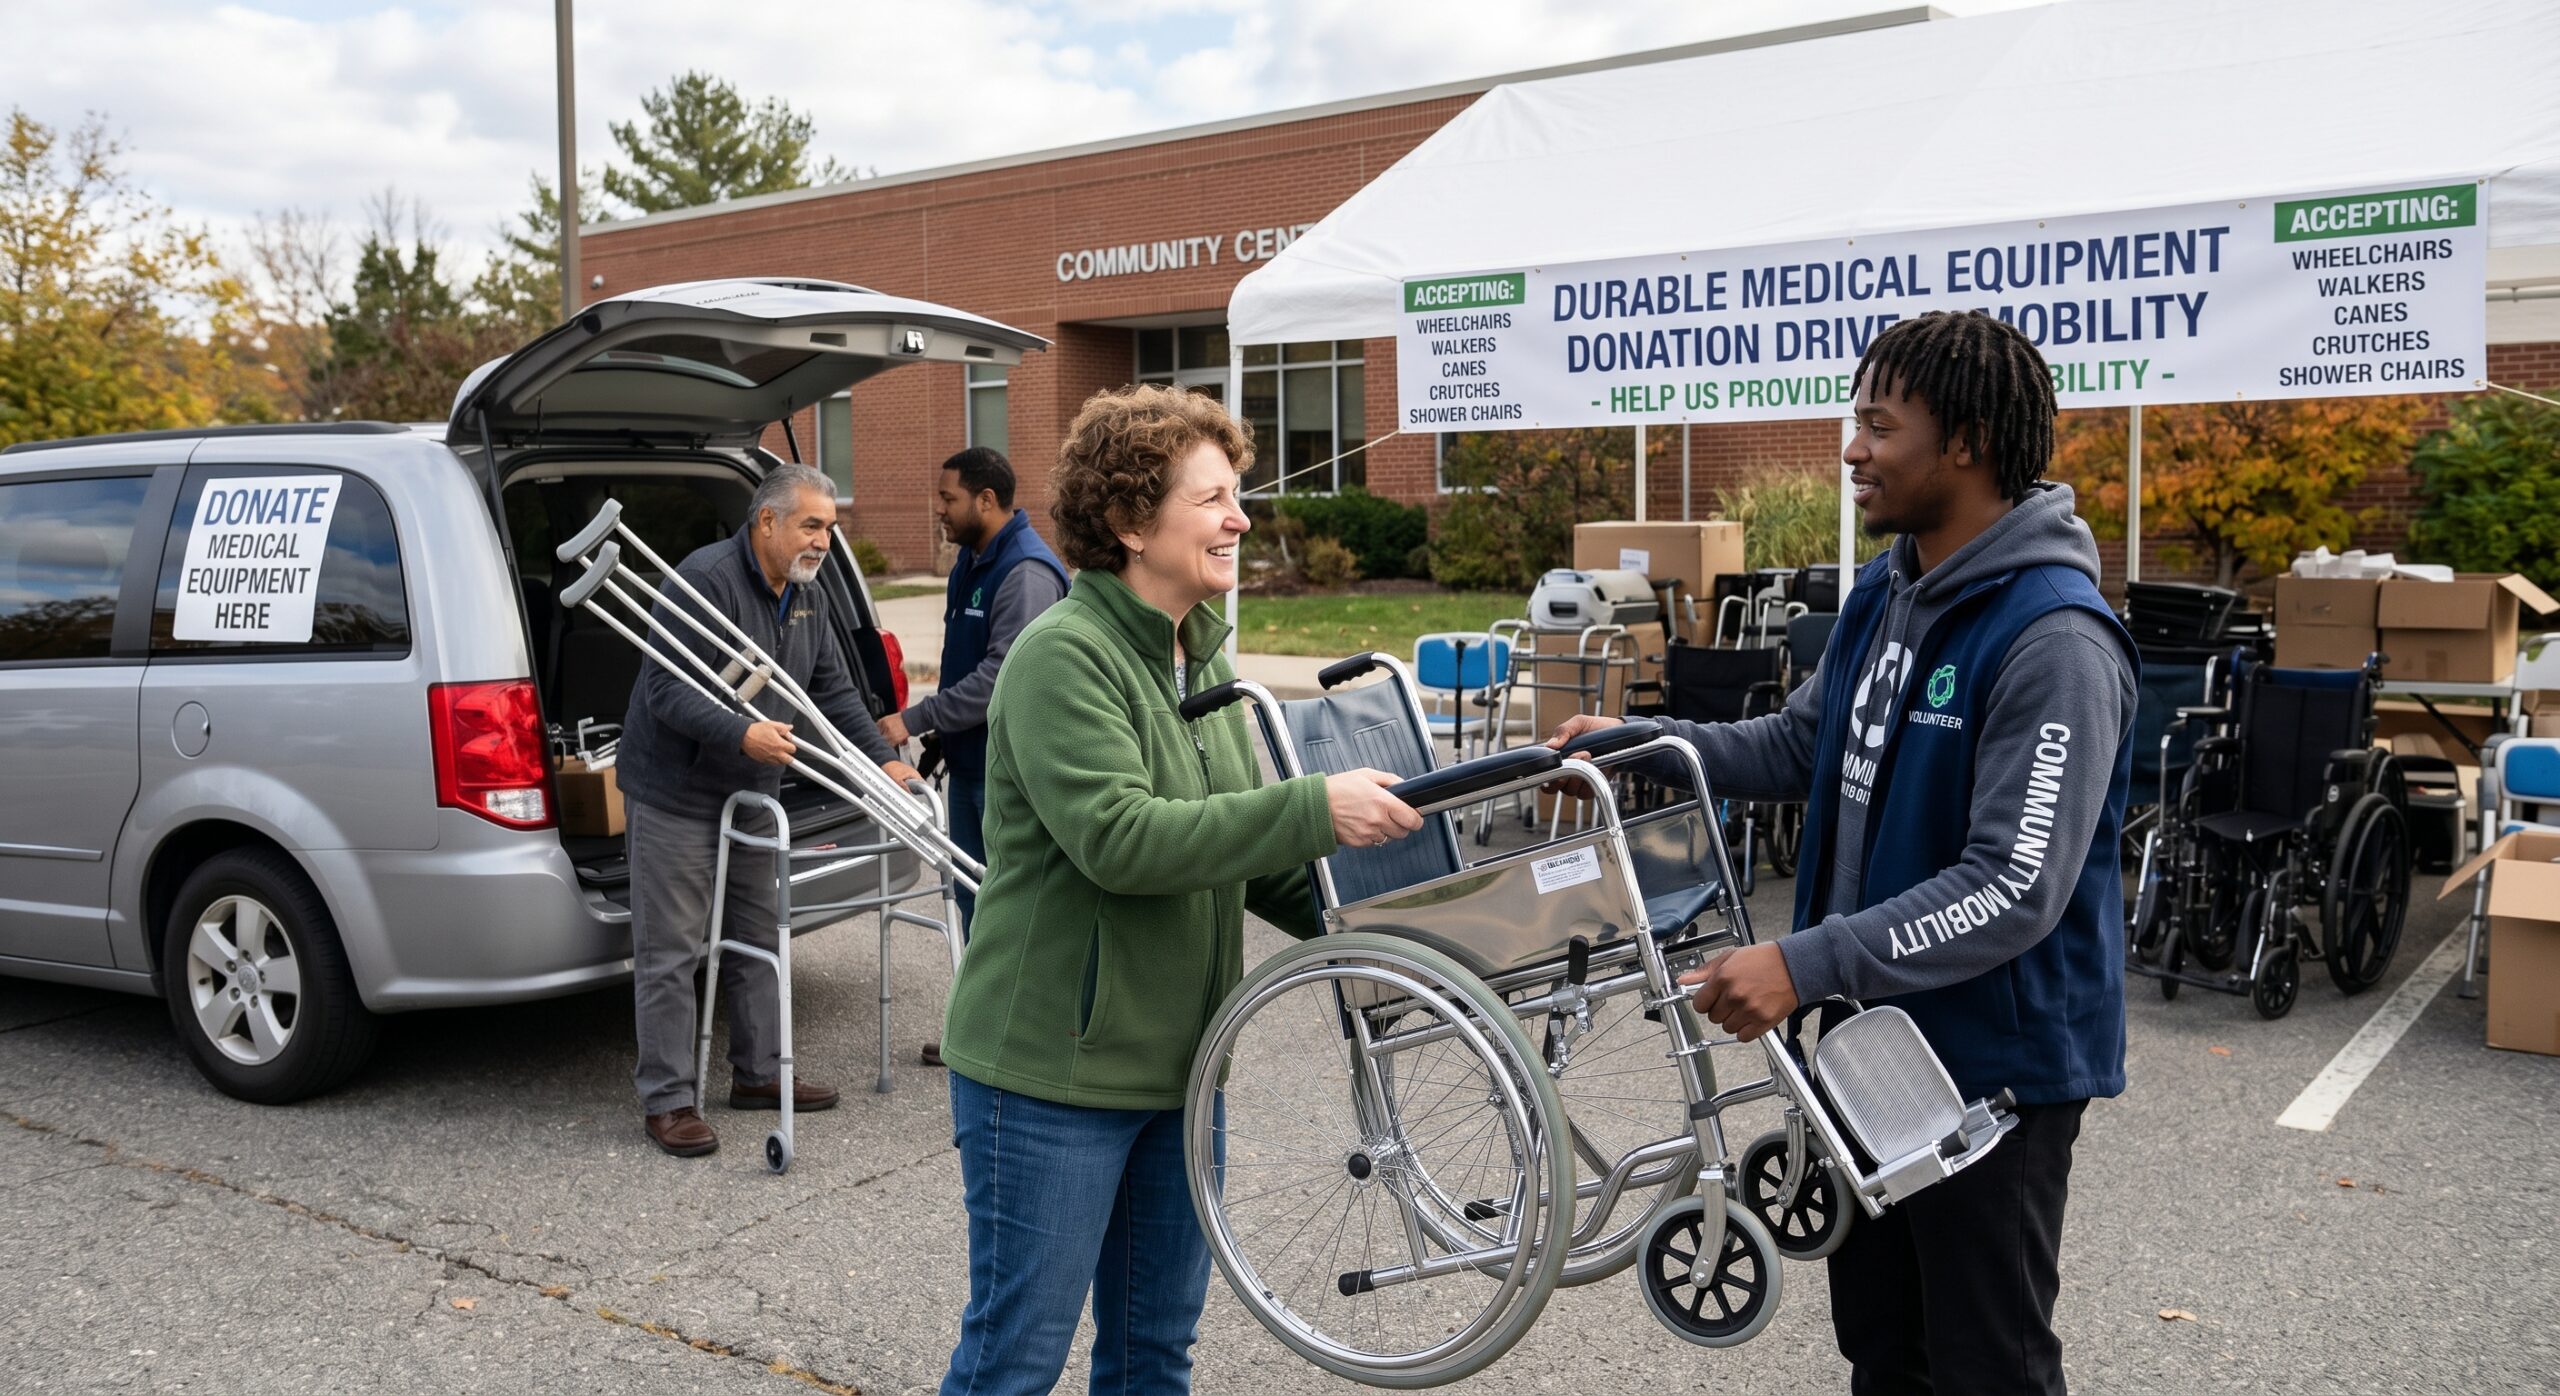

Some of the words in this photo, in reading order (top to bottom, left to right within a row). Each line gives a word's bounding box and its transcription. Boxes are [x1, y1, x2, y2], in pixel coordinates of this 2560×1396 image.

[2291, 196, 2458, 233] ACCEPTING:
[1056, 235, 1223, 282] COMMUNITY
[2291, 239, 2453, 271] WHEELCHAIRS
[1554, 271, 1728, 322] DURABLE
[1743, 254, 1931, 309] MEDICAL
[1948, 226, 2231, 296] EQUIPMENT
[2317, 270, 2426, 298] WALKERS
[1415, 280, 1515, 306] ACCEPTING:
[1416, 312, 1512, 335] WHEELCHAIRS
[2334, 302, 2408, 326] CANES
[1431, 336, 1497, 356] WALKERS
[1568, 324, 1760, 374] DONATION
[2312, 330, 2430, 356] CRUTCHES
[1442, 359, 1487, 378] CANES
[2278, 363, 2372, 387] SHOWER
[2380, 358, 2465, 382] CHAIRS
[1429, 381, 1501, 401] CRUTCHES
[1611, 385, 1675, 414] HELP
[1686, 381, 1720, 410] US
[1728, 374, 1850, 407] PROVIDE
[1409, 406, 1467, 424] SHOWER
[1471, 403, 1523, 421] CHAIRS
[203, 487, 330, 526] DONATE
[207, 532, 300, 560] MEDICAL
[187, 567, 311, 597] EQUIPMENT
[215, 602, 271, 629] HERE
[1908, 710, 1963, 730] VOLUNTEER
[1997, 722, 2071, 902] COMMUNITY
[1888, 884, 2013, 959] MOBILITY
